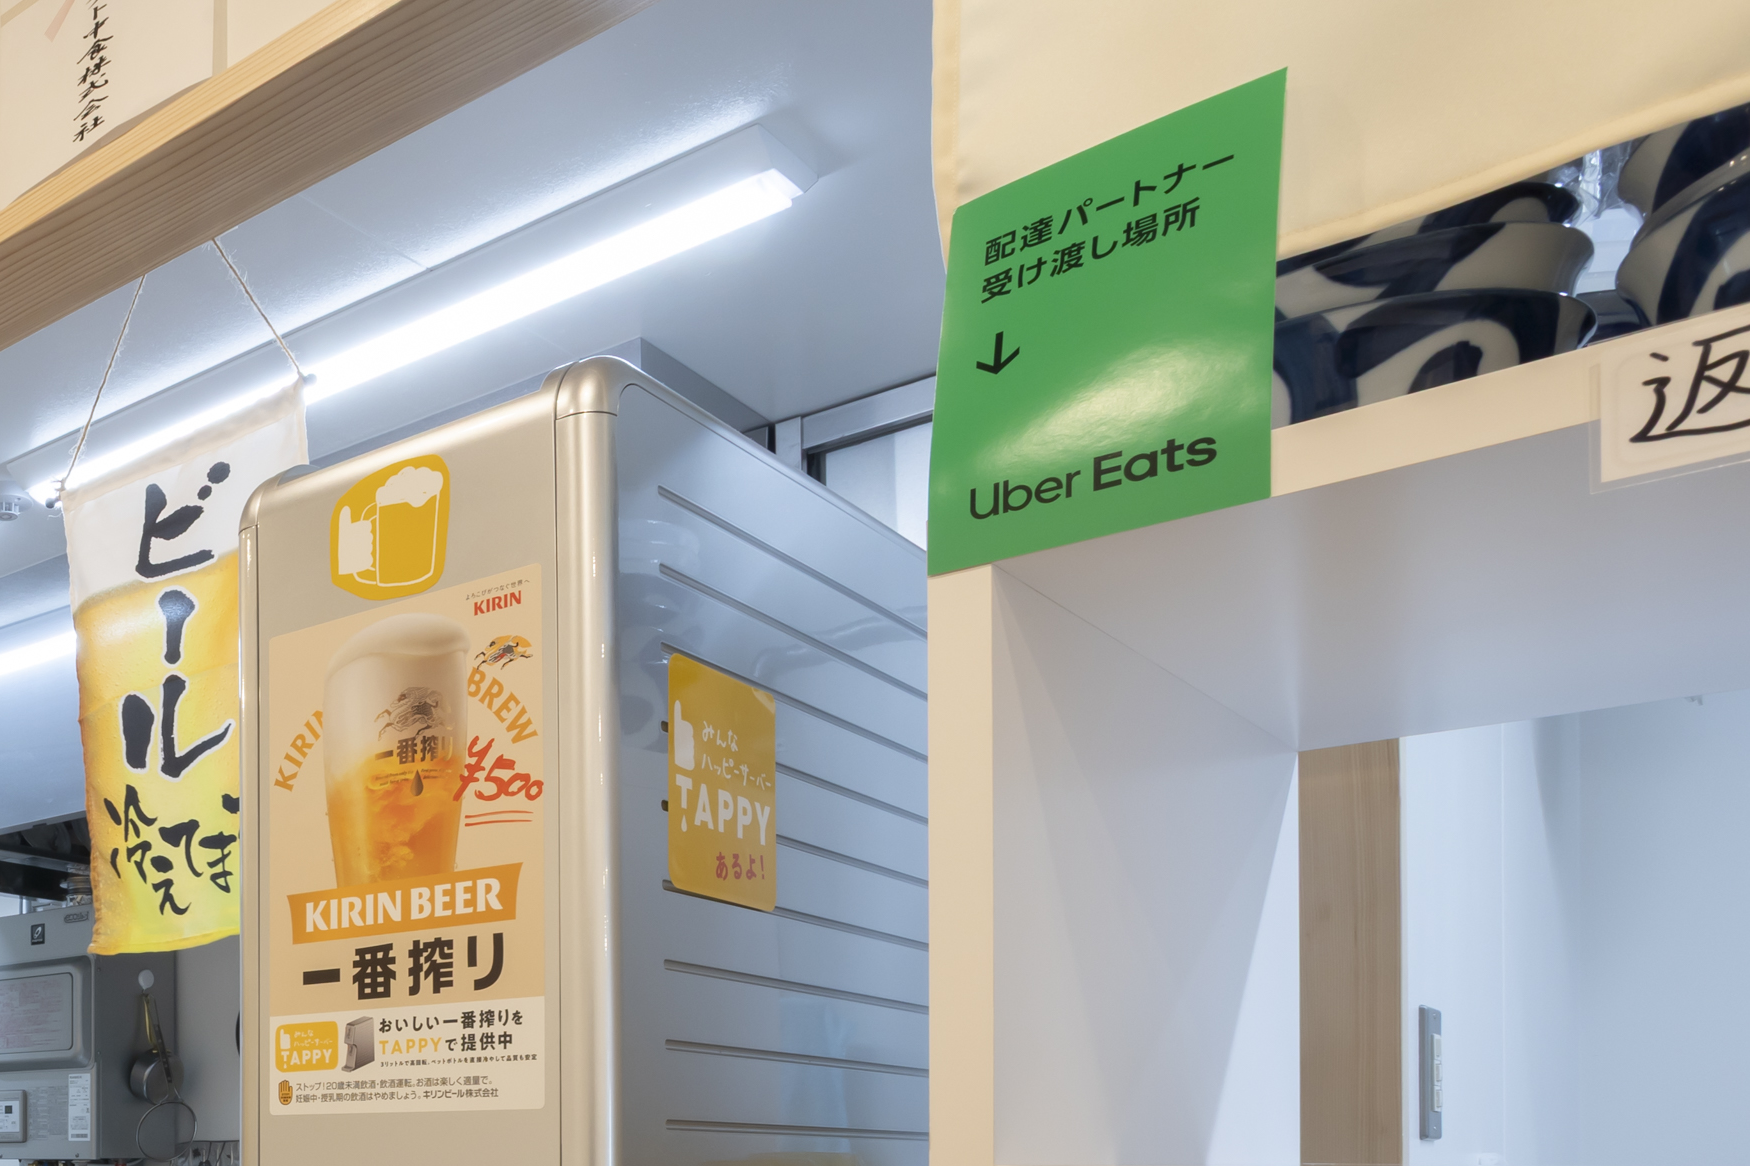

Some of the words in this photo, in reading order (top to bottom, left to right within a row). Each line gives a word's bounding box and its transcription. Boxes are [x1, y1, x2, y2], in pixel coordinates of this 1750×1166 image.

[984, 154, 1235, 266] 配達パートナー
[980, 197, 1201, 304] 受け渡し場所
[969, 468, 1081, 521] Uber
[1092, 436, 1218, 492] Eats
[119, 460, 233, 779] ビール
[465, 579, 530, 601] よろこびがつなぐ世界へ
[473, 590, 522, 616] KIRIN
[466, 667, 540, 745] BREW
[701, 720, 739, 752] みんな
[374, 734, 454, 766] 一番搾り
[452, 734, 544, 803] ¥500
[701, 753, 772, 791] ハッピーサーバー
[675, 773, 771, 846] TAPPY
[103, 784, 240, 916] 冷えてま
[715, 851, 766, 881] あるよ!
[304, 890, 402, 933] KIRIN
[409, 877, 504, 929] BEER
[302, 932, 504, 1001] 一番搾り
[378, 1008, 524, 1034] おいしい一番搾りを
[281, 1048, 333, 1067] TAPPY
